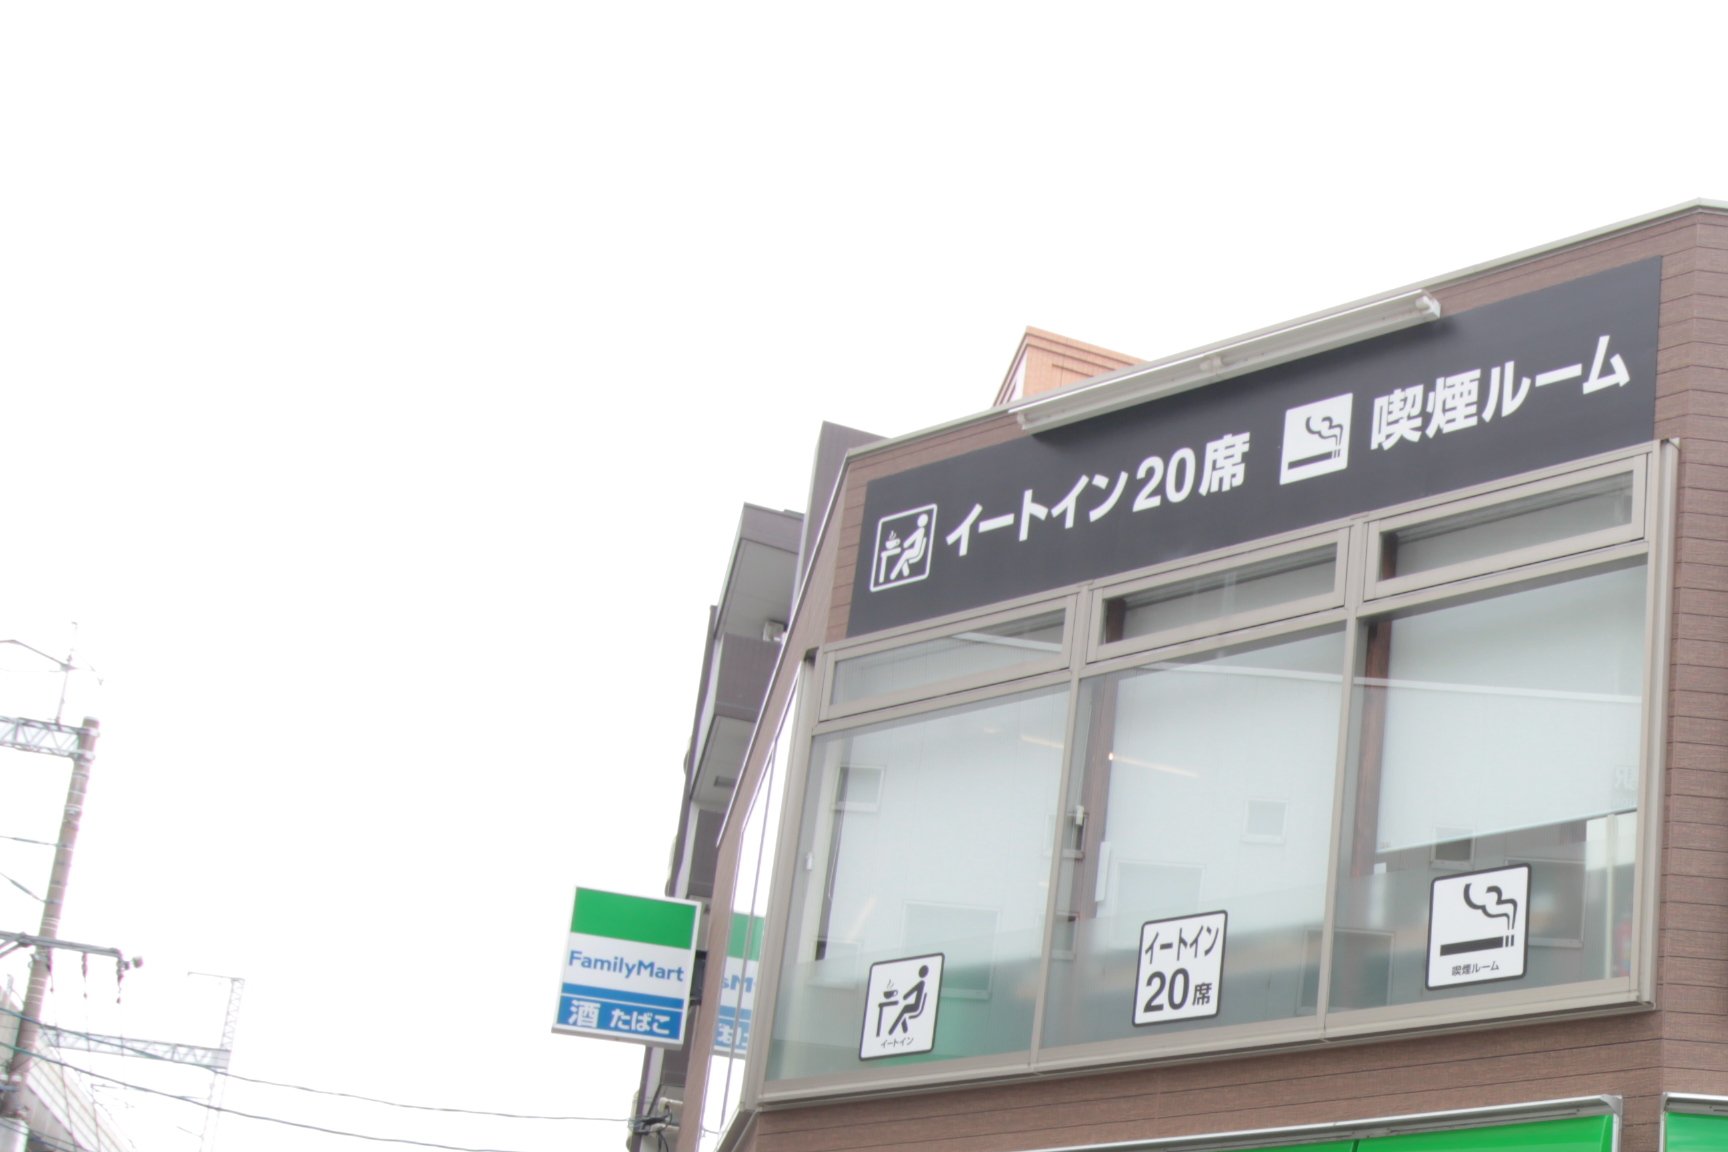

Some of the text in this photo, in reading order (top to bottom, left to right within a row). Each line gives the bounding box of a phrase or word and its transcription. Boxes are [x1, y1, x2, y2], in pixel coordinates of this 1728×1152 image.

[1370, 335, 1631, 450] 喫煙ルーム
[945, 433, 1251, 557] イートイン20席
[568, 949, 685, 982] FamilyMart
[1143, 924, 1219, 967] イートイン
[1142, 966, 1214, 1015] 20席
[1450, 960, 1501, 979] 喫煙ルーム
[567, 999, 671, 1036] 酒 たばこ
